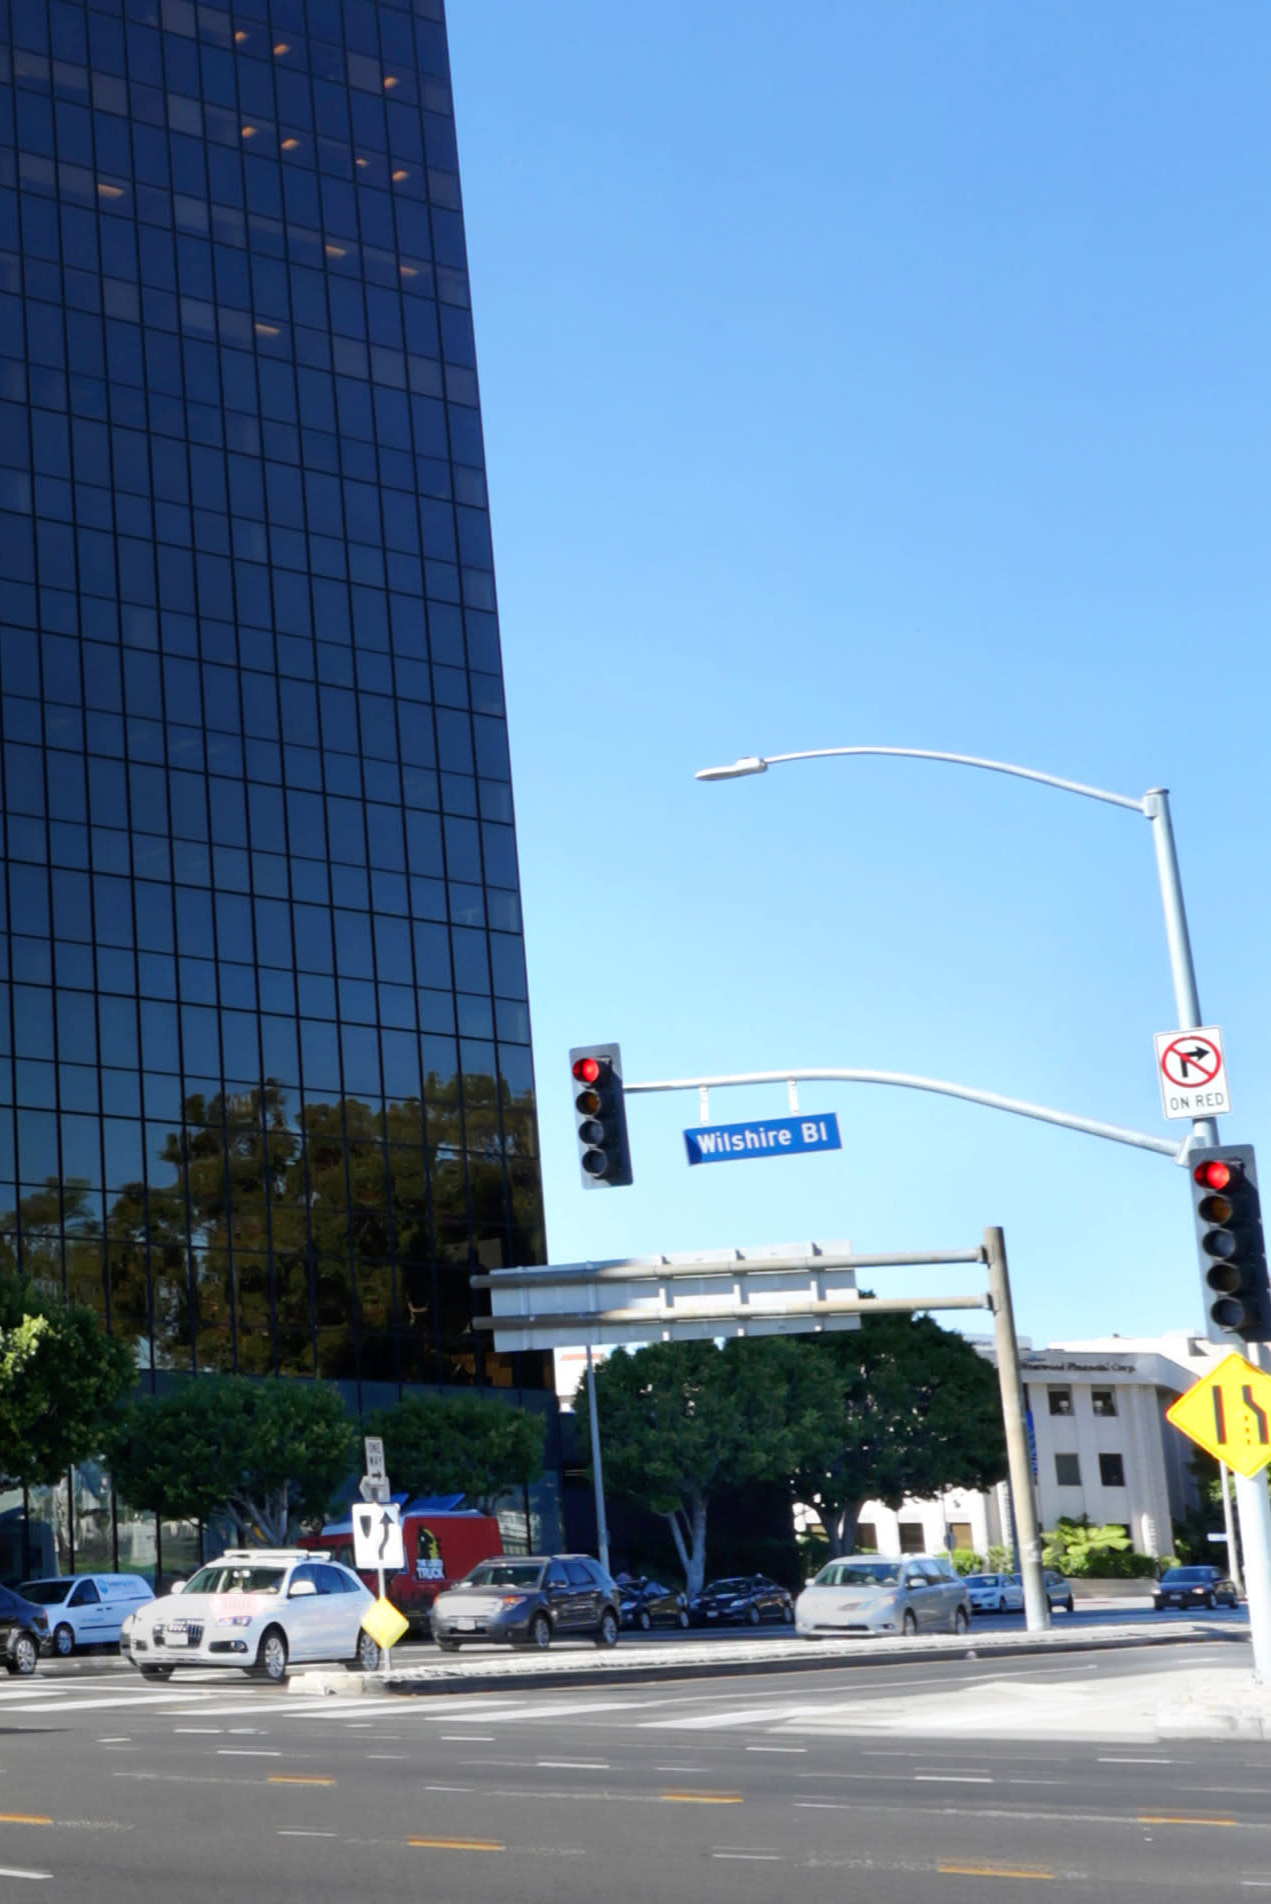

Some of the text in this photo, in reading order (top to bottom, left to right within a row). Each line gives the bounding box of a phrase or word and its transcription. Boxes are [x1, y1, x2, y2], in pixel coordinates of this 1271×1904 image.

[1170, 1092, 1224, 1110] ON RED
[696, 1121, 828, 1154] Wilshire Bl
[369, 1442, 381, 1453] ONE
